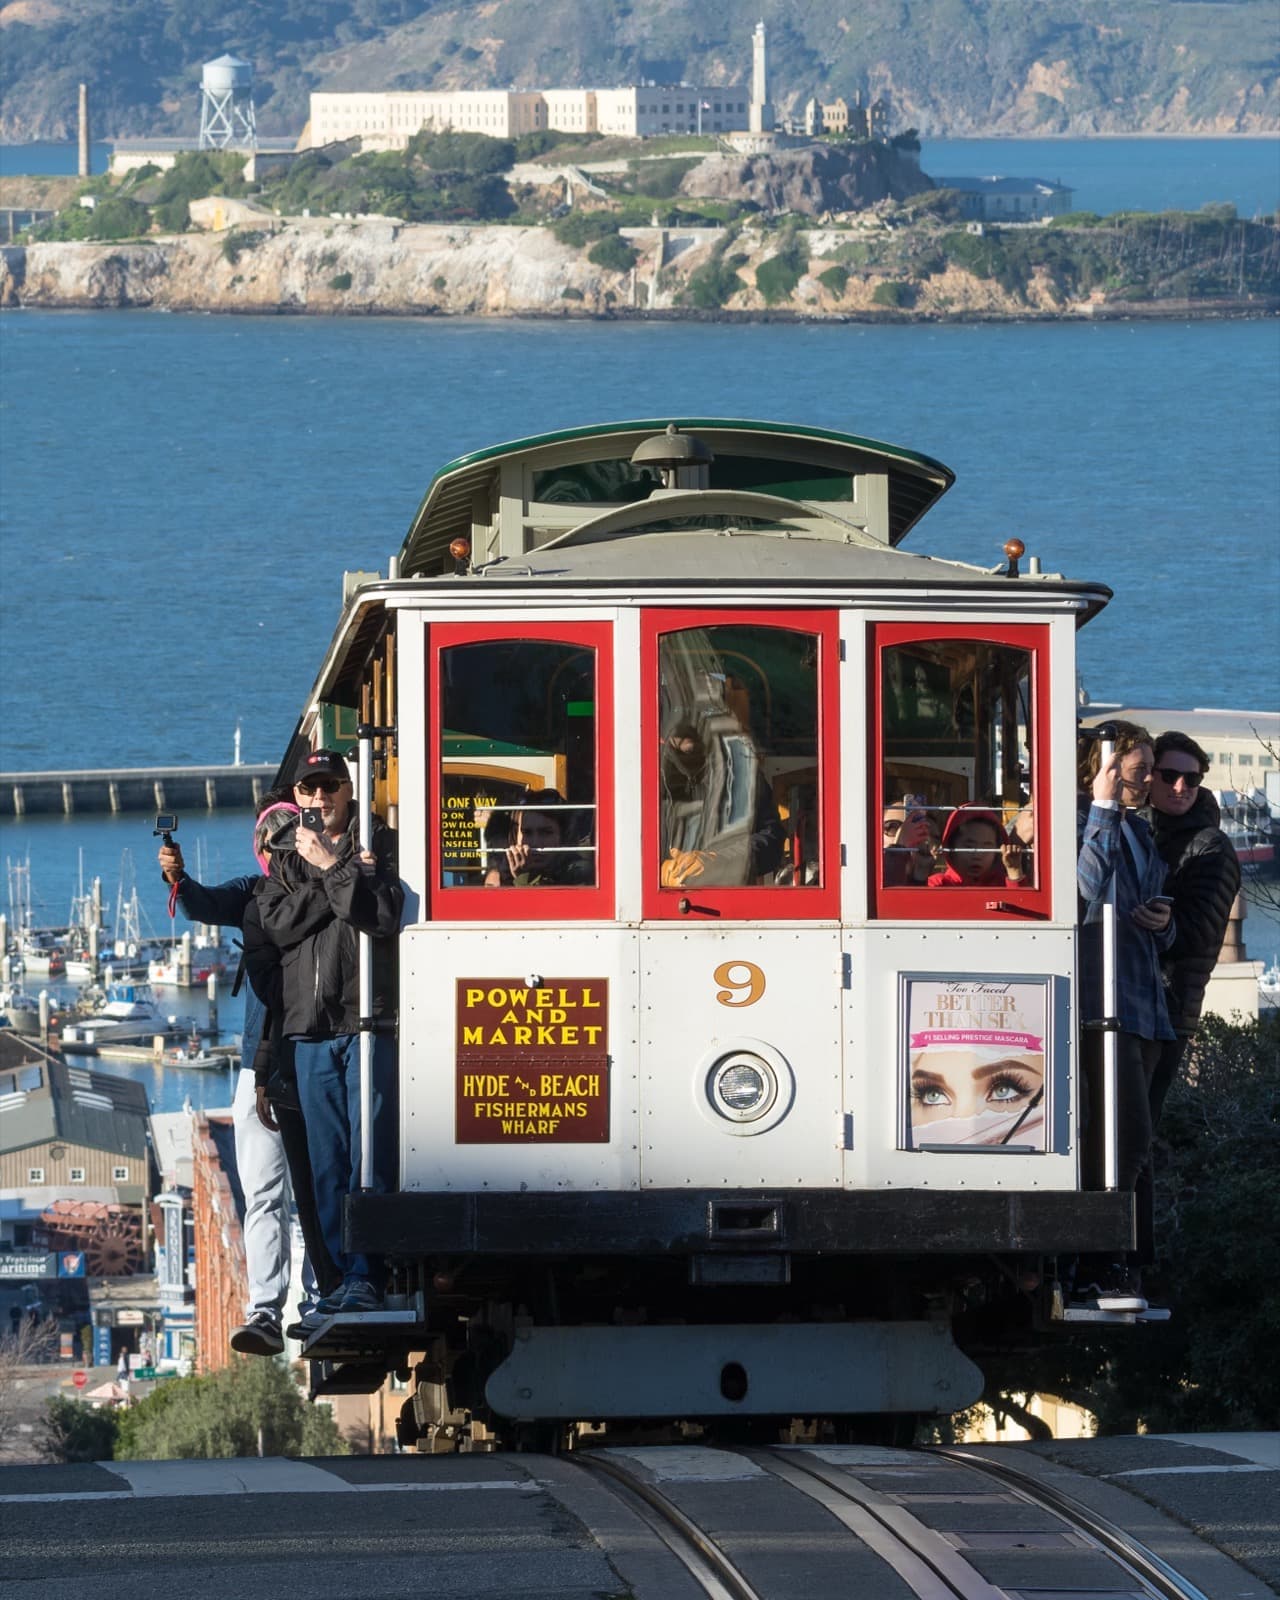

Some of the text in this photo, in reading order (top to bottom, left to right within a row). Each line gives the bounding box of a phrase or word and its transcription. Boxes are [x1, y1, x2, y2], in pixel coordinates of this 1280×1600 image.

[474, 797, 497, 808] WAY
[713, 960, 766, 1007] 9
[946, 982, 1011, 994] Too Faced
[466, 988, 600, 1007] POWELL
[936, 994, 1016, 1012] BETTER
[501, 1009, 566, 1024] AND
[924, 1012, 1026, 1029] THAN SEX
[463, 1026, 602, 1045] MARKET
[995, 1035, 1028, 1043] MASCARA
[463, 1075, 599, 1096] HYDE AND BEACH
[474, 1103, 588, 1117] FISHERMANS
[502, 1120, 560, 1134] WHARF
[0, 1264, 46, 1273] aritime
